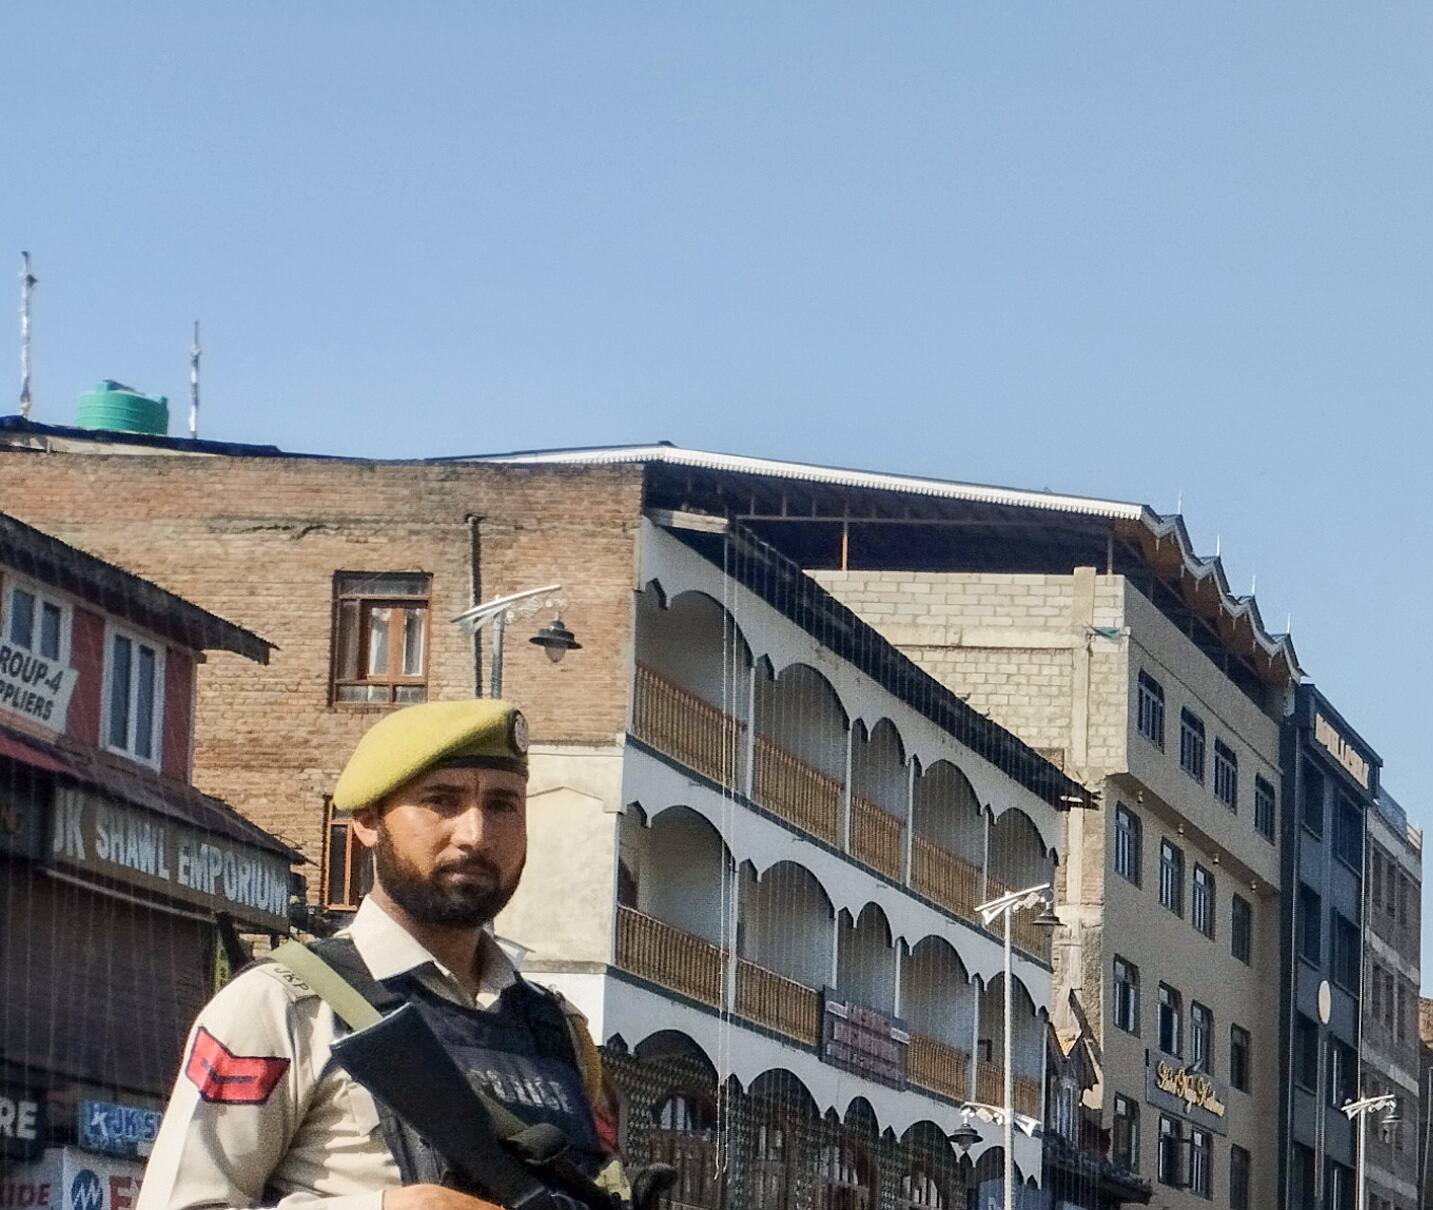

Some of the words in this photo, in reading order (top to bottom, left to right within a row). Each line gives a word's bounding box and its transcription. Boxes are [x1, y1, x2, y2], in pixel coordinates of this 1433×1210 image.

[55, 787, 86, 861] JK
[96, 817, 170, 881] SHAWL
[178, 841, 289, 919] EMPORIUM
[272, 965, 310, 993] JKP
